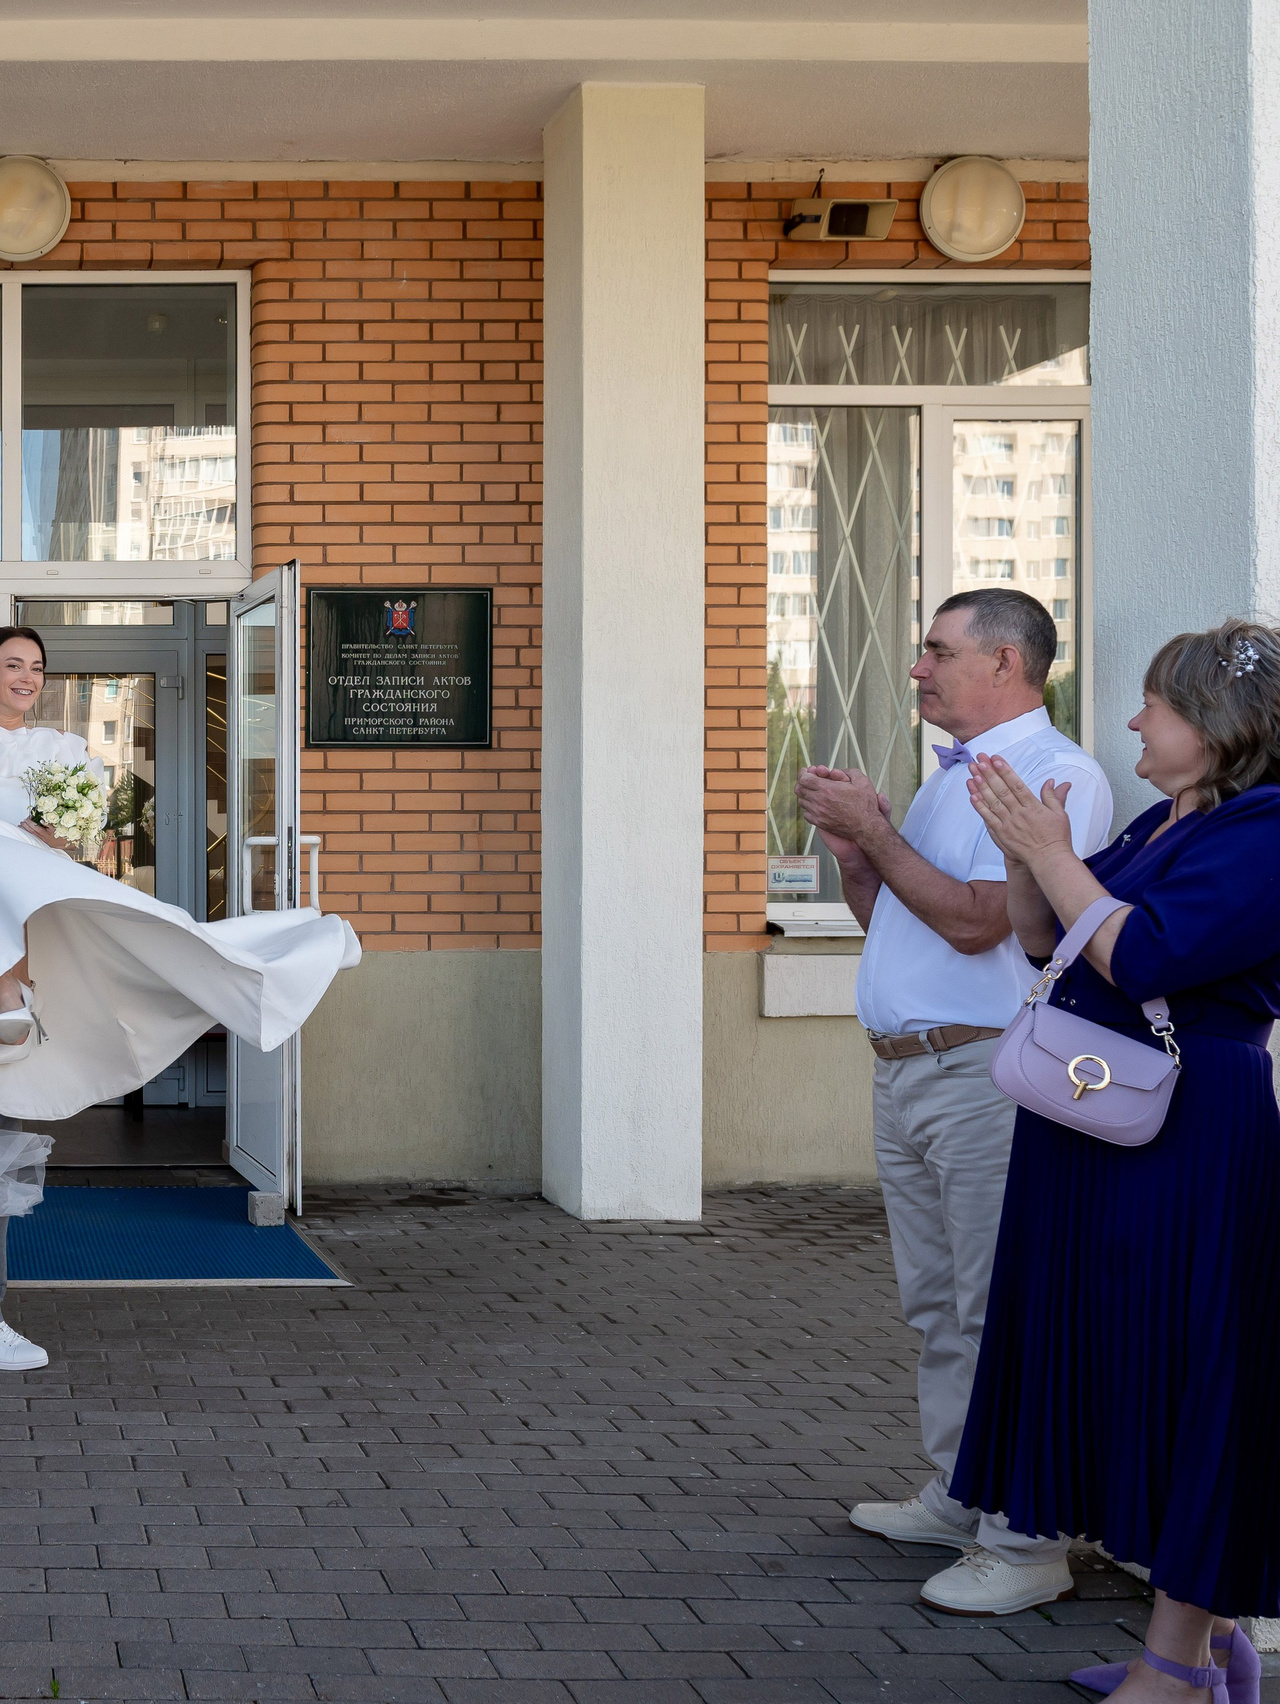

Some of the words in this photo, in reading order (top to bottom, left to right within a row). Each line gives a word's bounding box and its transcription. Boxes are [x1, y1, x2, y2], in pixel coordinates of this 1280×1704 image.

[328, 676, 370, 685] ОТДЕЛ
[376, 676, 424, 685] ЗАПИСИ
[433, 676, 471, 685] АКТОВ
[350, 689, 450, 699] ГРАЖДАНСКОГО
[362, 702, 437, 712] СОСТОЯНИЯ
